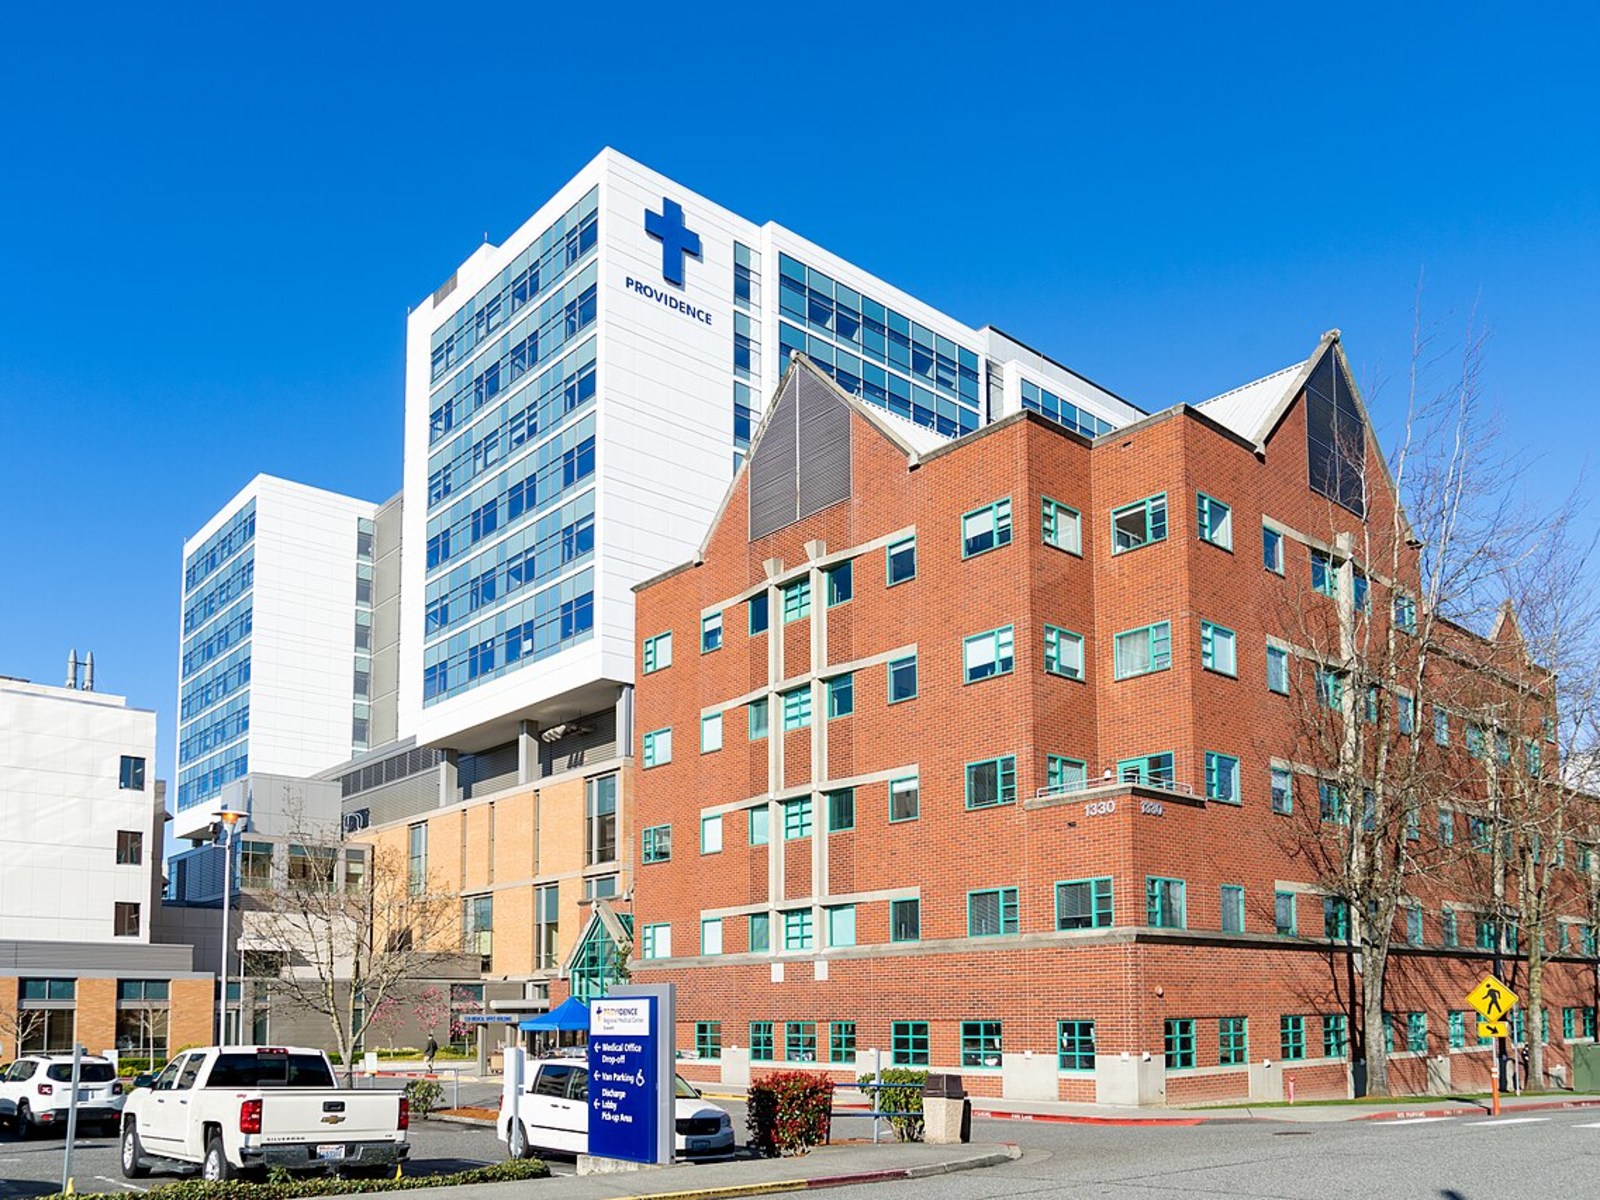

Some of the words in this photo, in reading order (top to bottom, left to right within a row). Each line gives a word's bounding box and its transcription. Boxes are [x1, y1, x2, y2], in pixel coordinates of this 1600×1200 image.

[625, 276, 712, 326] PROVIDENCE
[1084, 800, 1115, 816] 1330
[602, 1042, 624, 1051] Medical
[624, 1042, 642, 1053] Office
[602, 1054, 625, 1065] Drop-off
[602, 1072, 613, 1081] Van
[613, 1072, 635, 1084] Parking
[602, 1088, 626, 1100] Discharge
[602, 1099, 618, 1111] Lobby
